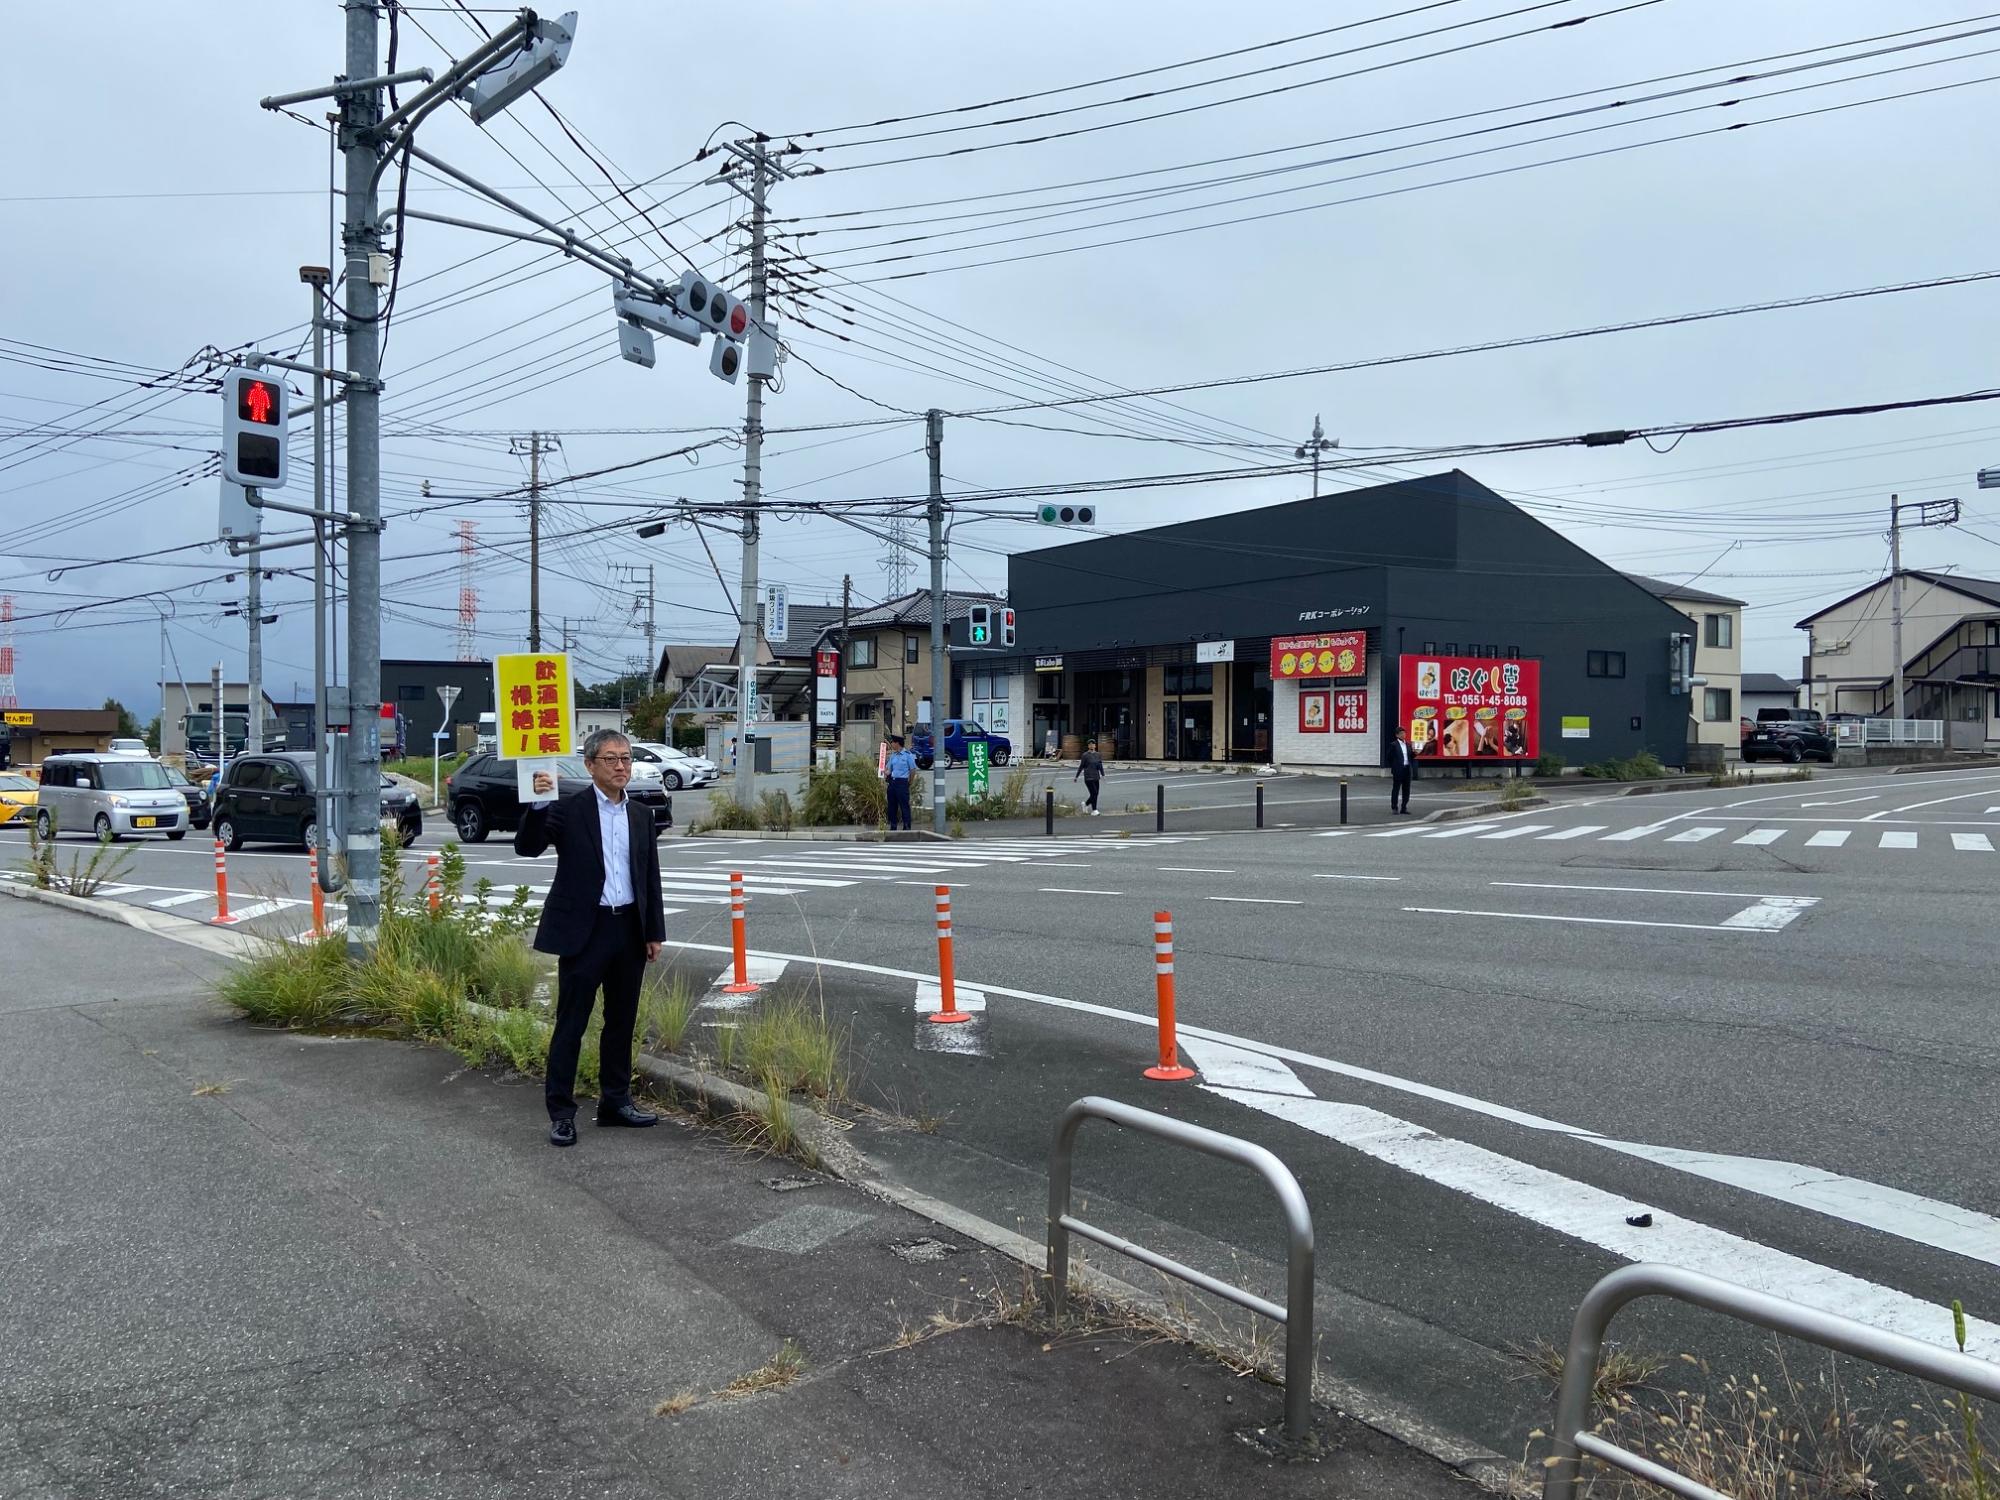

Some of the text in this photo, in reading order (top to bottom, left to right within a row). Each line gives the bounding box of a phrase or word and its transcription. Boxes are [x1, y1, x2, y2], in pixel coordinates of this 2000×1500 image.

[1298, 605, 1370, 621] FRKコーポレーション
[1450, 663, 1520, 694] ほぐし堂
[535, 660, 561, 753] 飲酒運転
[1338, 694, 1363, 706] 0551
[1443, 694, 1528, 706] TEL:0551-45-8088
[510, 685, 534, 752] 根絶!
[1344, 706, 1358, 717] 45
[1338, 717, 1364, 729] 8088
